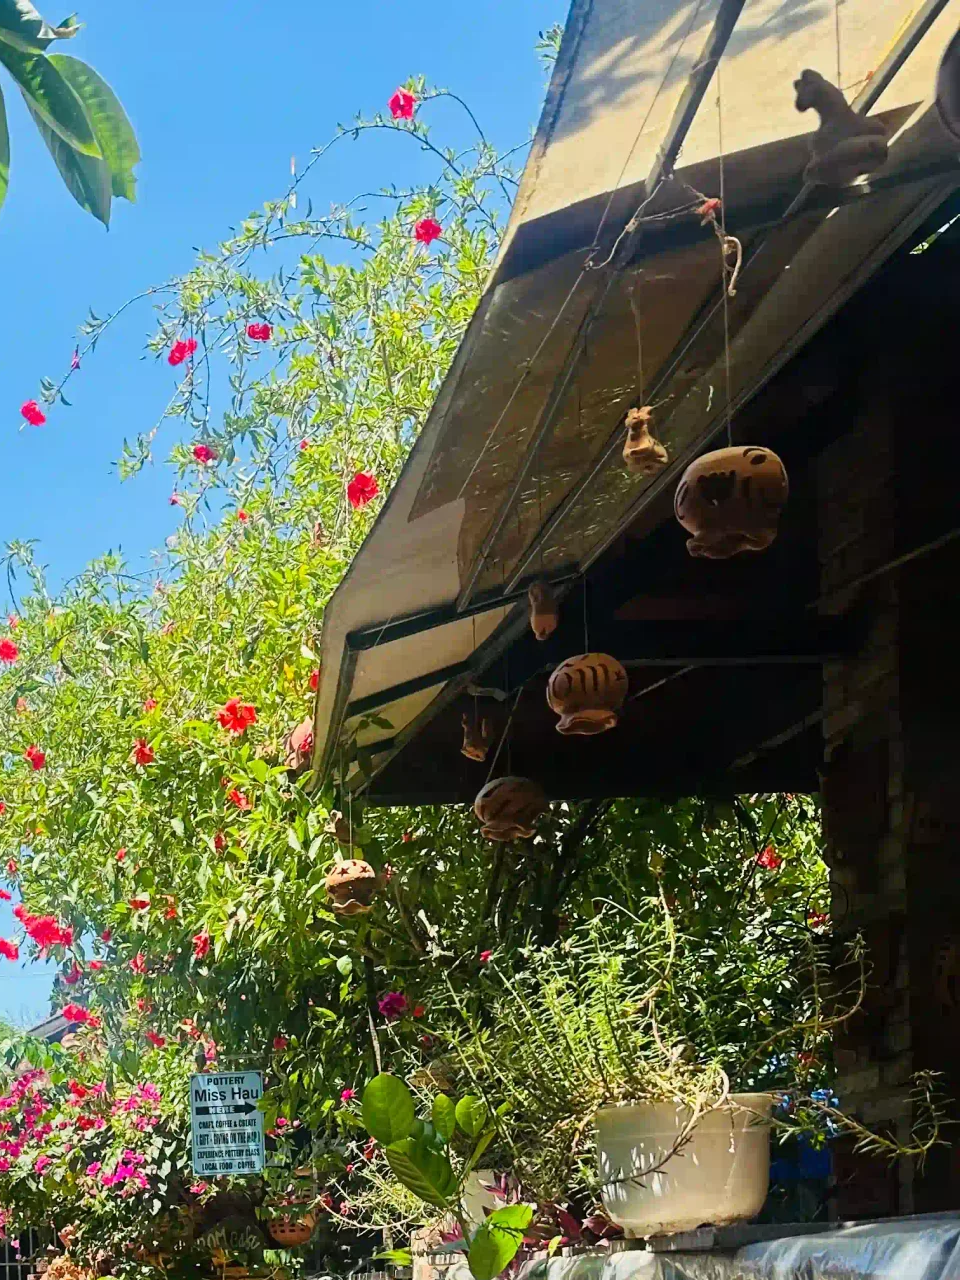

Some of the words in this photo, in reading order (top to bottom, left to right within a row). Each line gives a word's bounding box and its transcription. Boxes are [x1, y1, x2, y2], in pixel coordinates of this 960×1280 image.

[207, 1076, 245, 1085] POTTERY
[195, 1089, 226, 1102] Miss
[232, 1087, 258, 1100] Hau
[208, 1106, 235, 1114] HERE
[216, 1120, 232, 1128] COFFEE
[197, 1150, 224, 1159] EXPERIENCE
[225, 1149, 244, 1157] POTTERY
[245, 1148, 260, 1157] CLASS
[202, 1162, 217, 1171] LOCAL
[219, 1161, 233, 1170] FOOD
[237, 1161, 256, 1169] COFFEE
